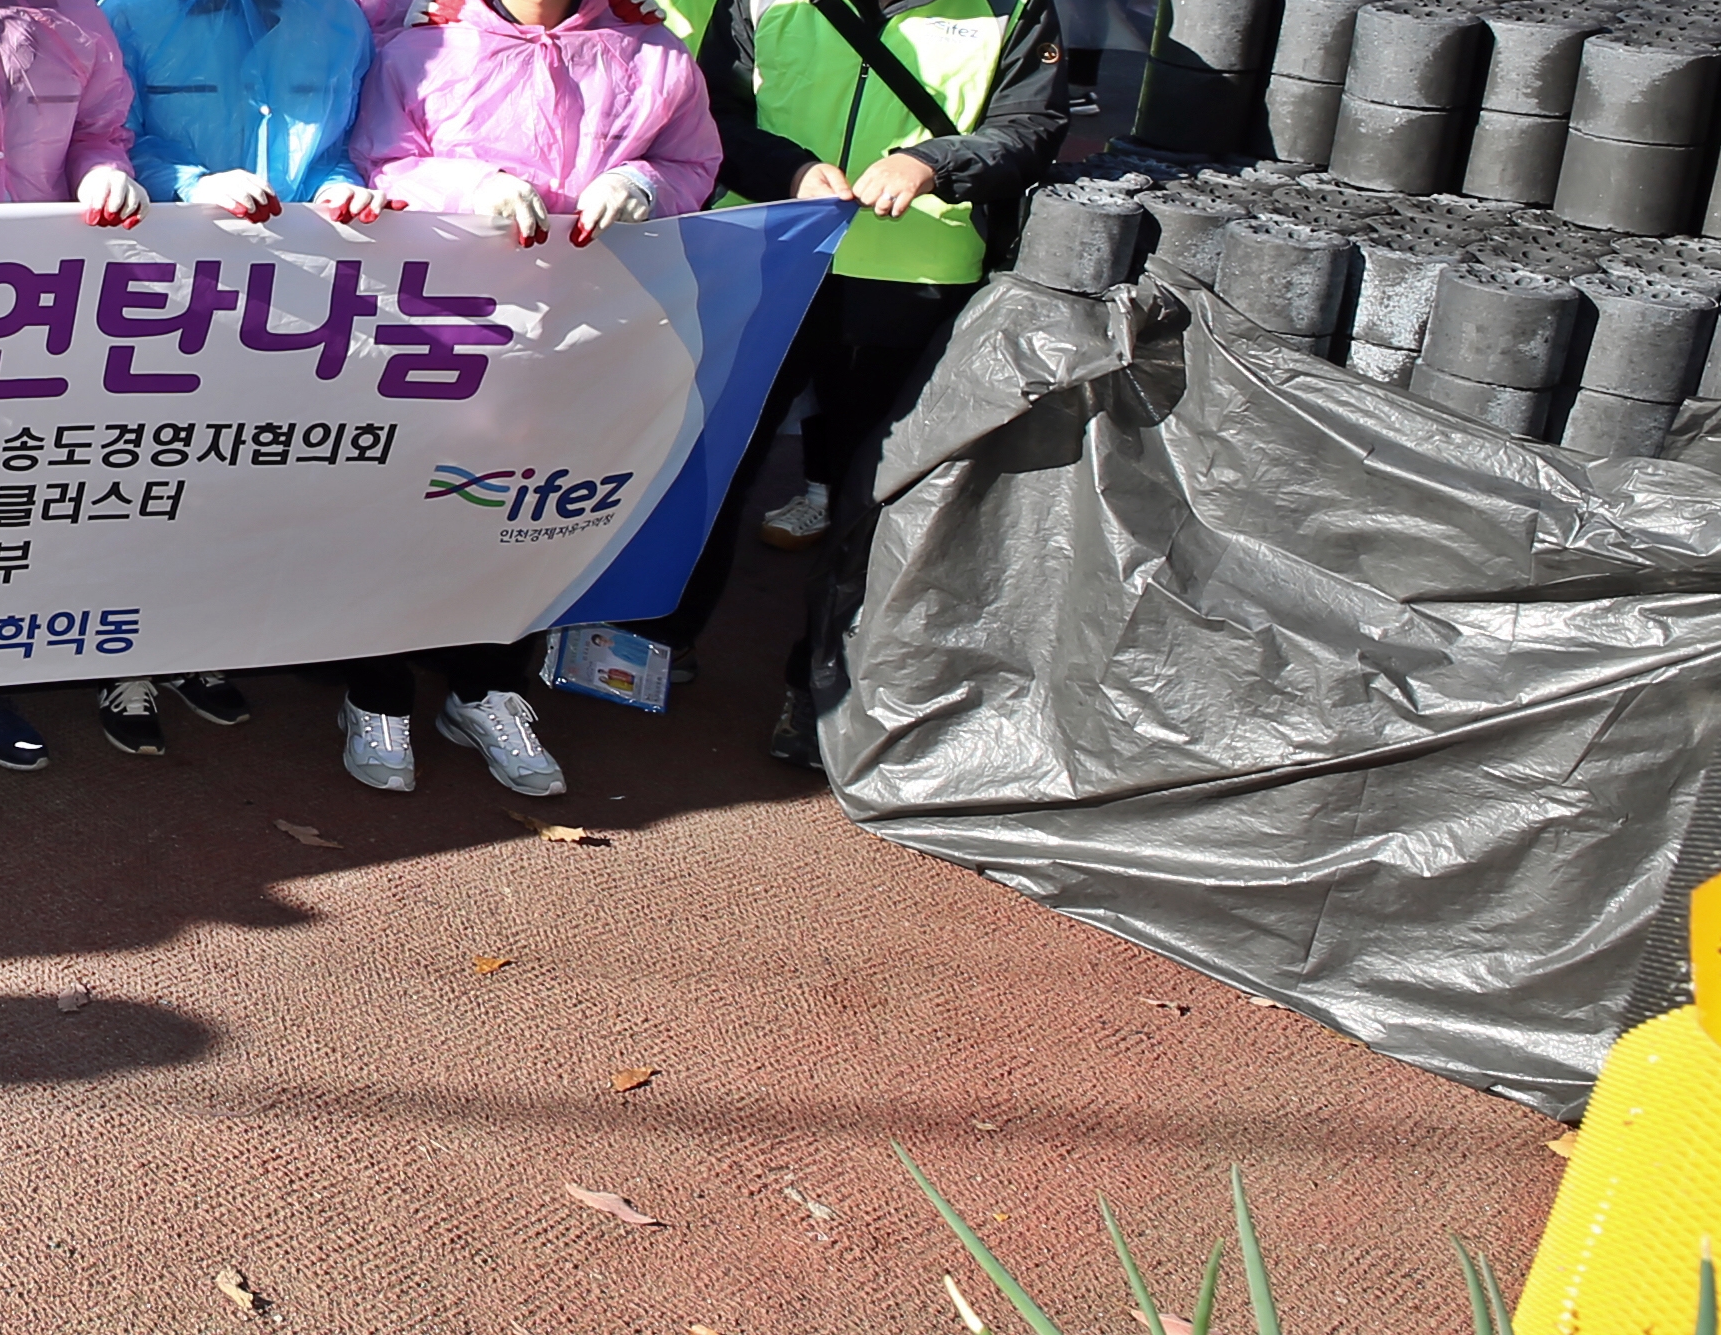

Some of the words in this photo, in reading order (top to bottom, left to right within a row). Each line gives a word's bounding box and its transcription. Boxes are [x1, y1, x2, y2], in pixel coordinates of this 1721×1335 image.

[1, 421, 397, 469] 송도경영자협의회
[506, 468, 634, 522] ifez
[499, 512, 616, 543] 인천경제자유구역청
